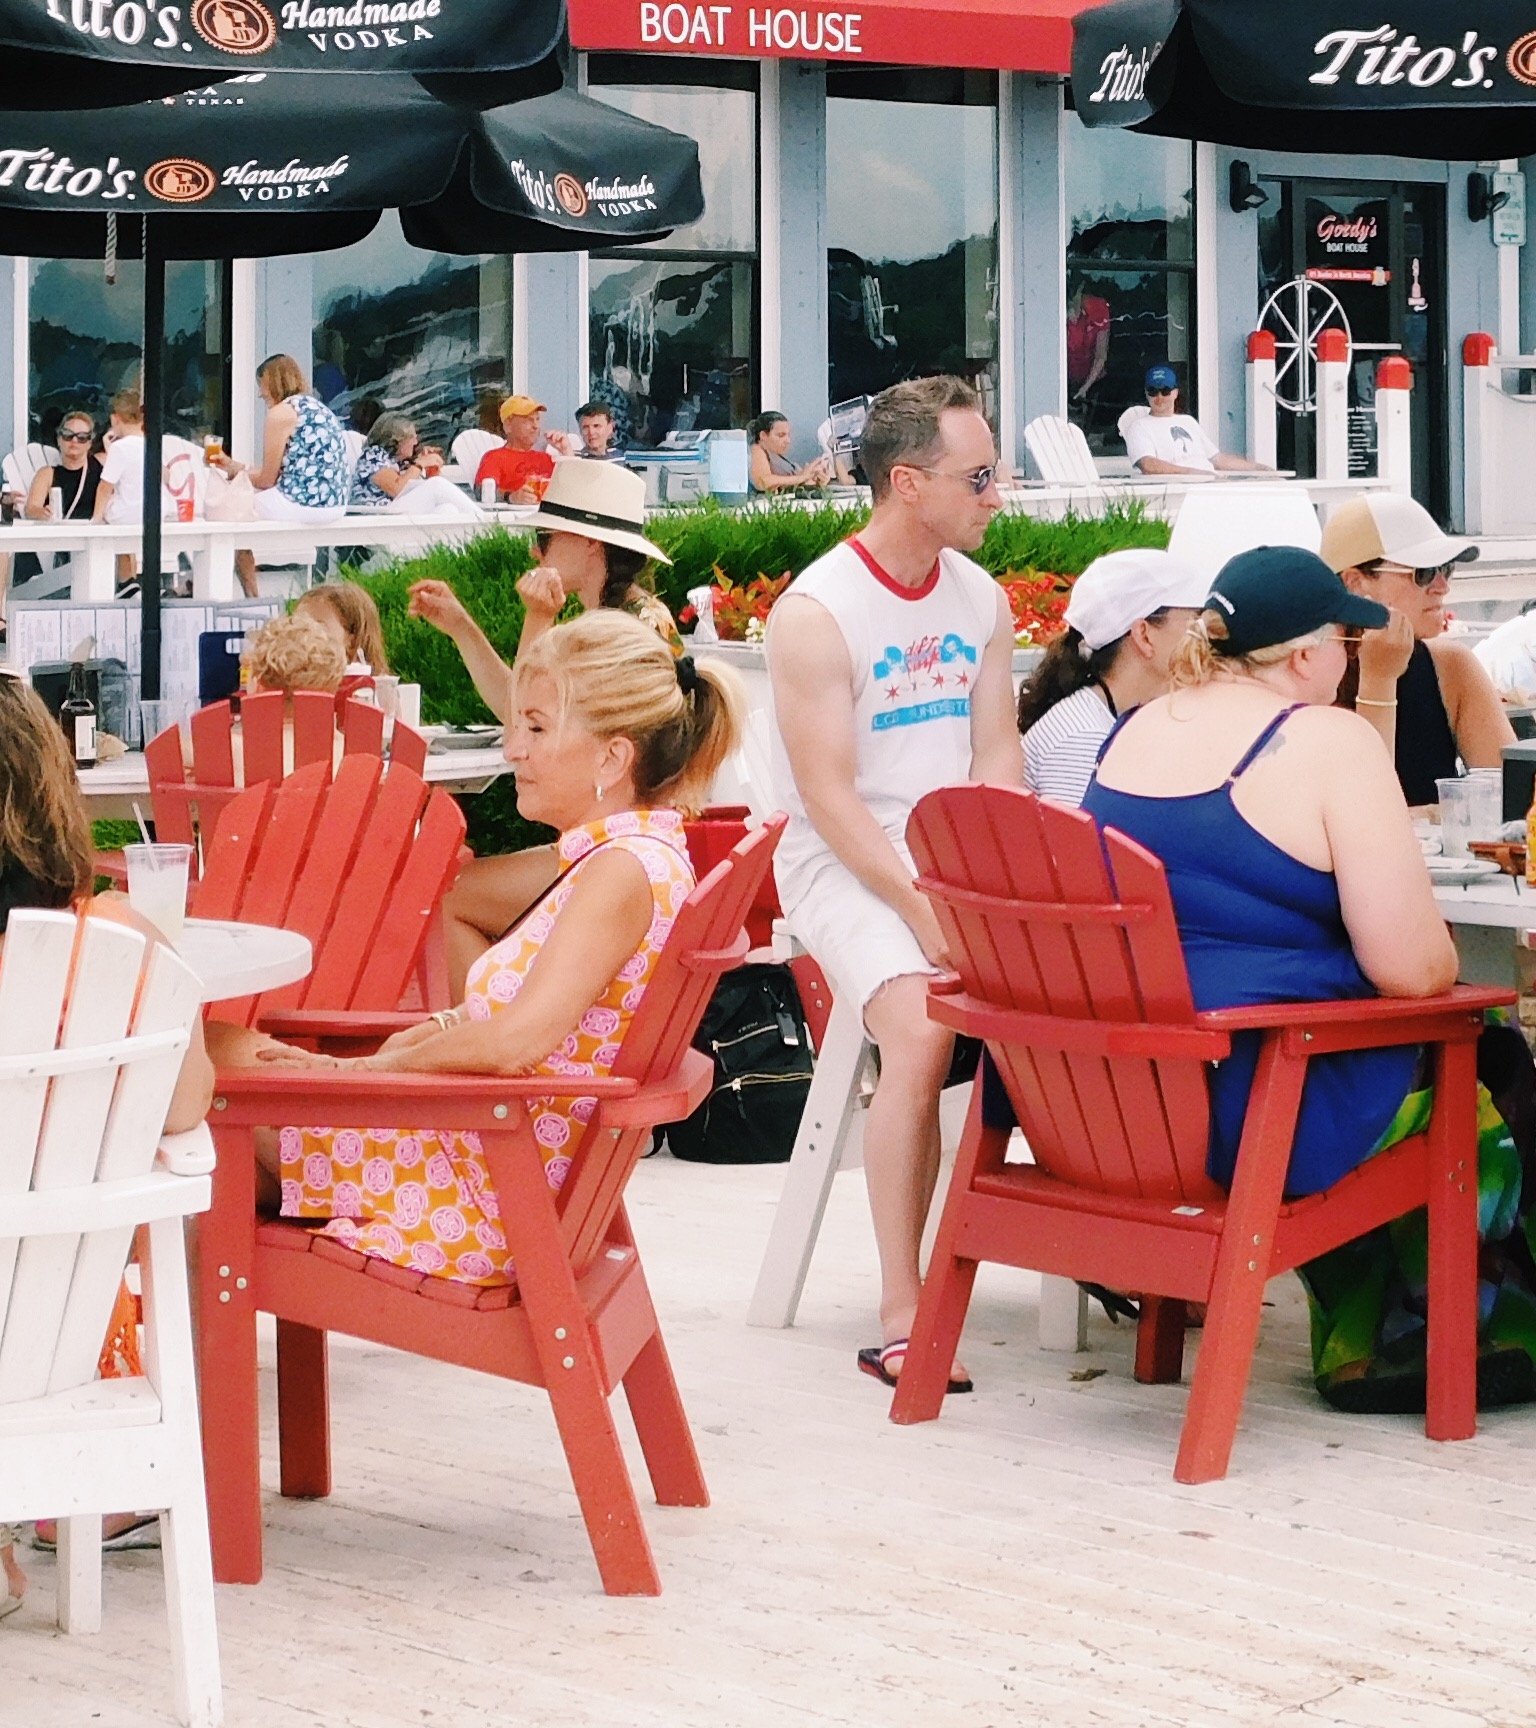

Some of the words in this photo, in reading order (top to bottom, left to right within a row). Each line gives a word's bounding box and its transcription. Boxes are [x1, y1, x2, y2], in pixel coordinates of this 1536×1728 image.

[307, 24, 435, 53] VODKA
[640, 2, 732, 46] BOAT
[749, 8, 863, 53] HOUSE
[185, 98, 245, 106] TEXAS
[220, 154, 350, 187] Handmade
[238, 180, 331, 202] VODKA
[584, 174, 655, 201] Handmade
[597, 198, 657, 217] VODKA
[1316, 214, 1378, 243] Gordy's
[1326, 242, 1344, 253] BOAT
[1344, 243, 1368, 253] HOUSE
